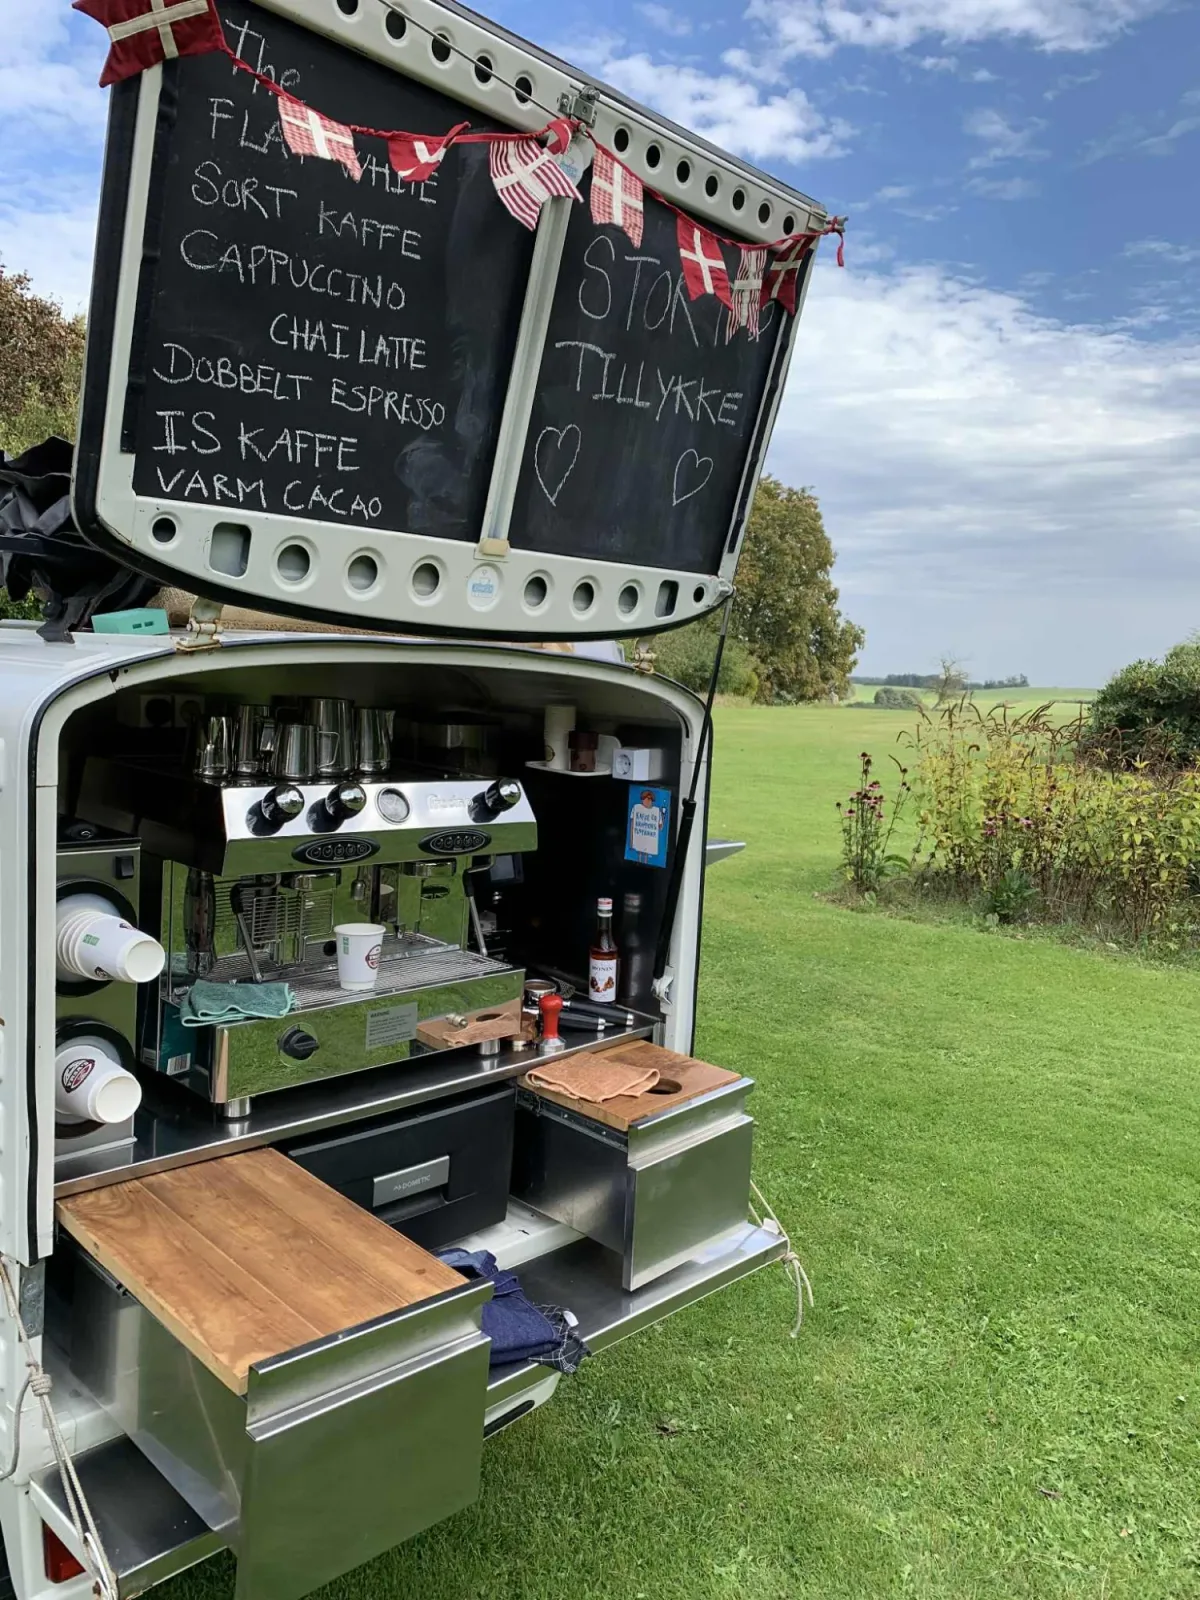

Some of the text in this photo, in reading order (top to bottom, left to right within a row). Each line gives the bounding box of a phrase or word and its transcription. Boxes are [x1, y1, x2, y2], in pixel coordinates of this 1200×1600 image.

[225, 19, 300, 95] The
[209, 98, 437, 204] FLA WHIE
[192, 161, 422, 260] SORT KAFFE
[180, 229, 406, 310] CAPPUCCINO
[269, 314, 427, 370] CHAI LATTE
[152, 342, 446, 431] DOBBELT ESPRESSO
[555, 341, 744, 426] TILLYKKE
[152, 410, 361, 472] IS KAFFE
[156, 466, 383, 520] VARM CACAO
